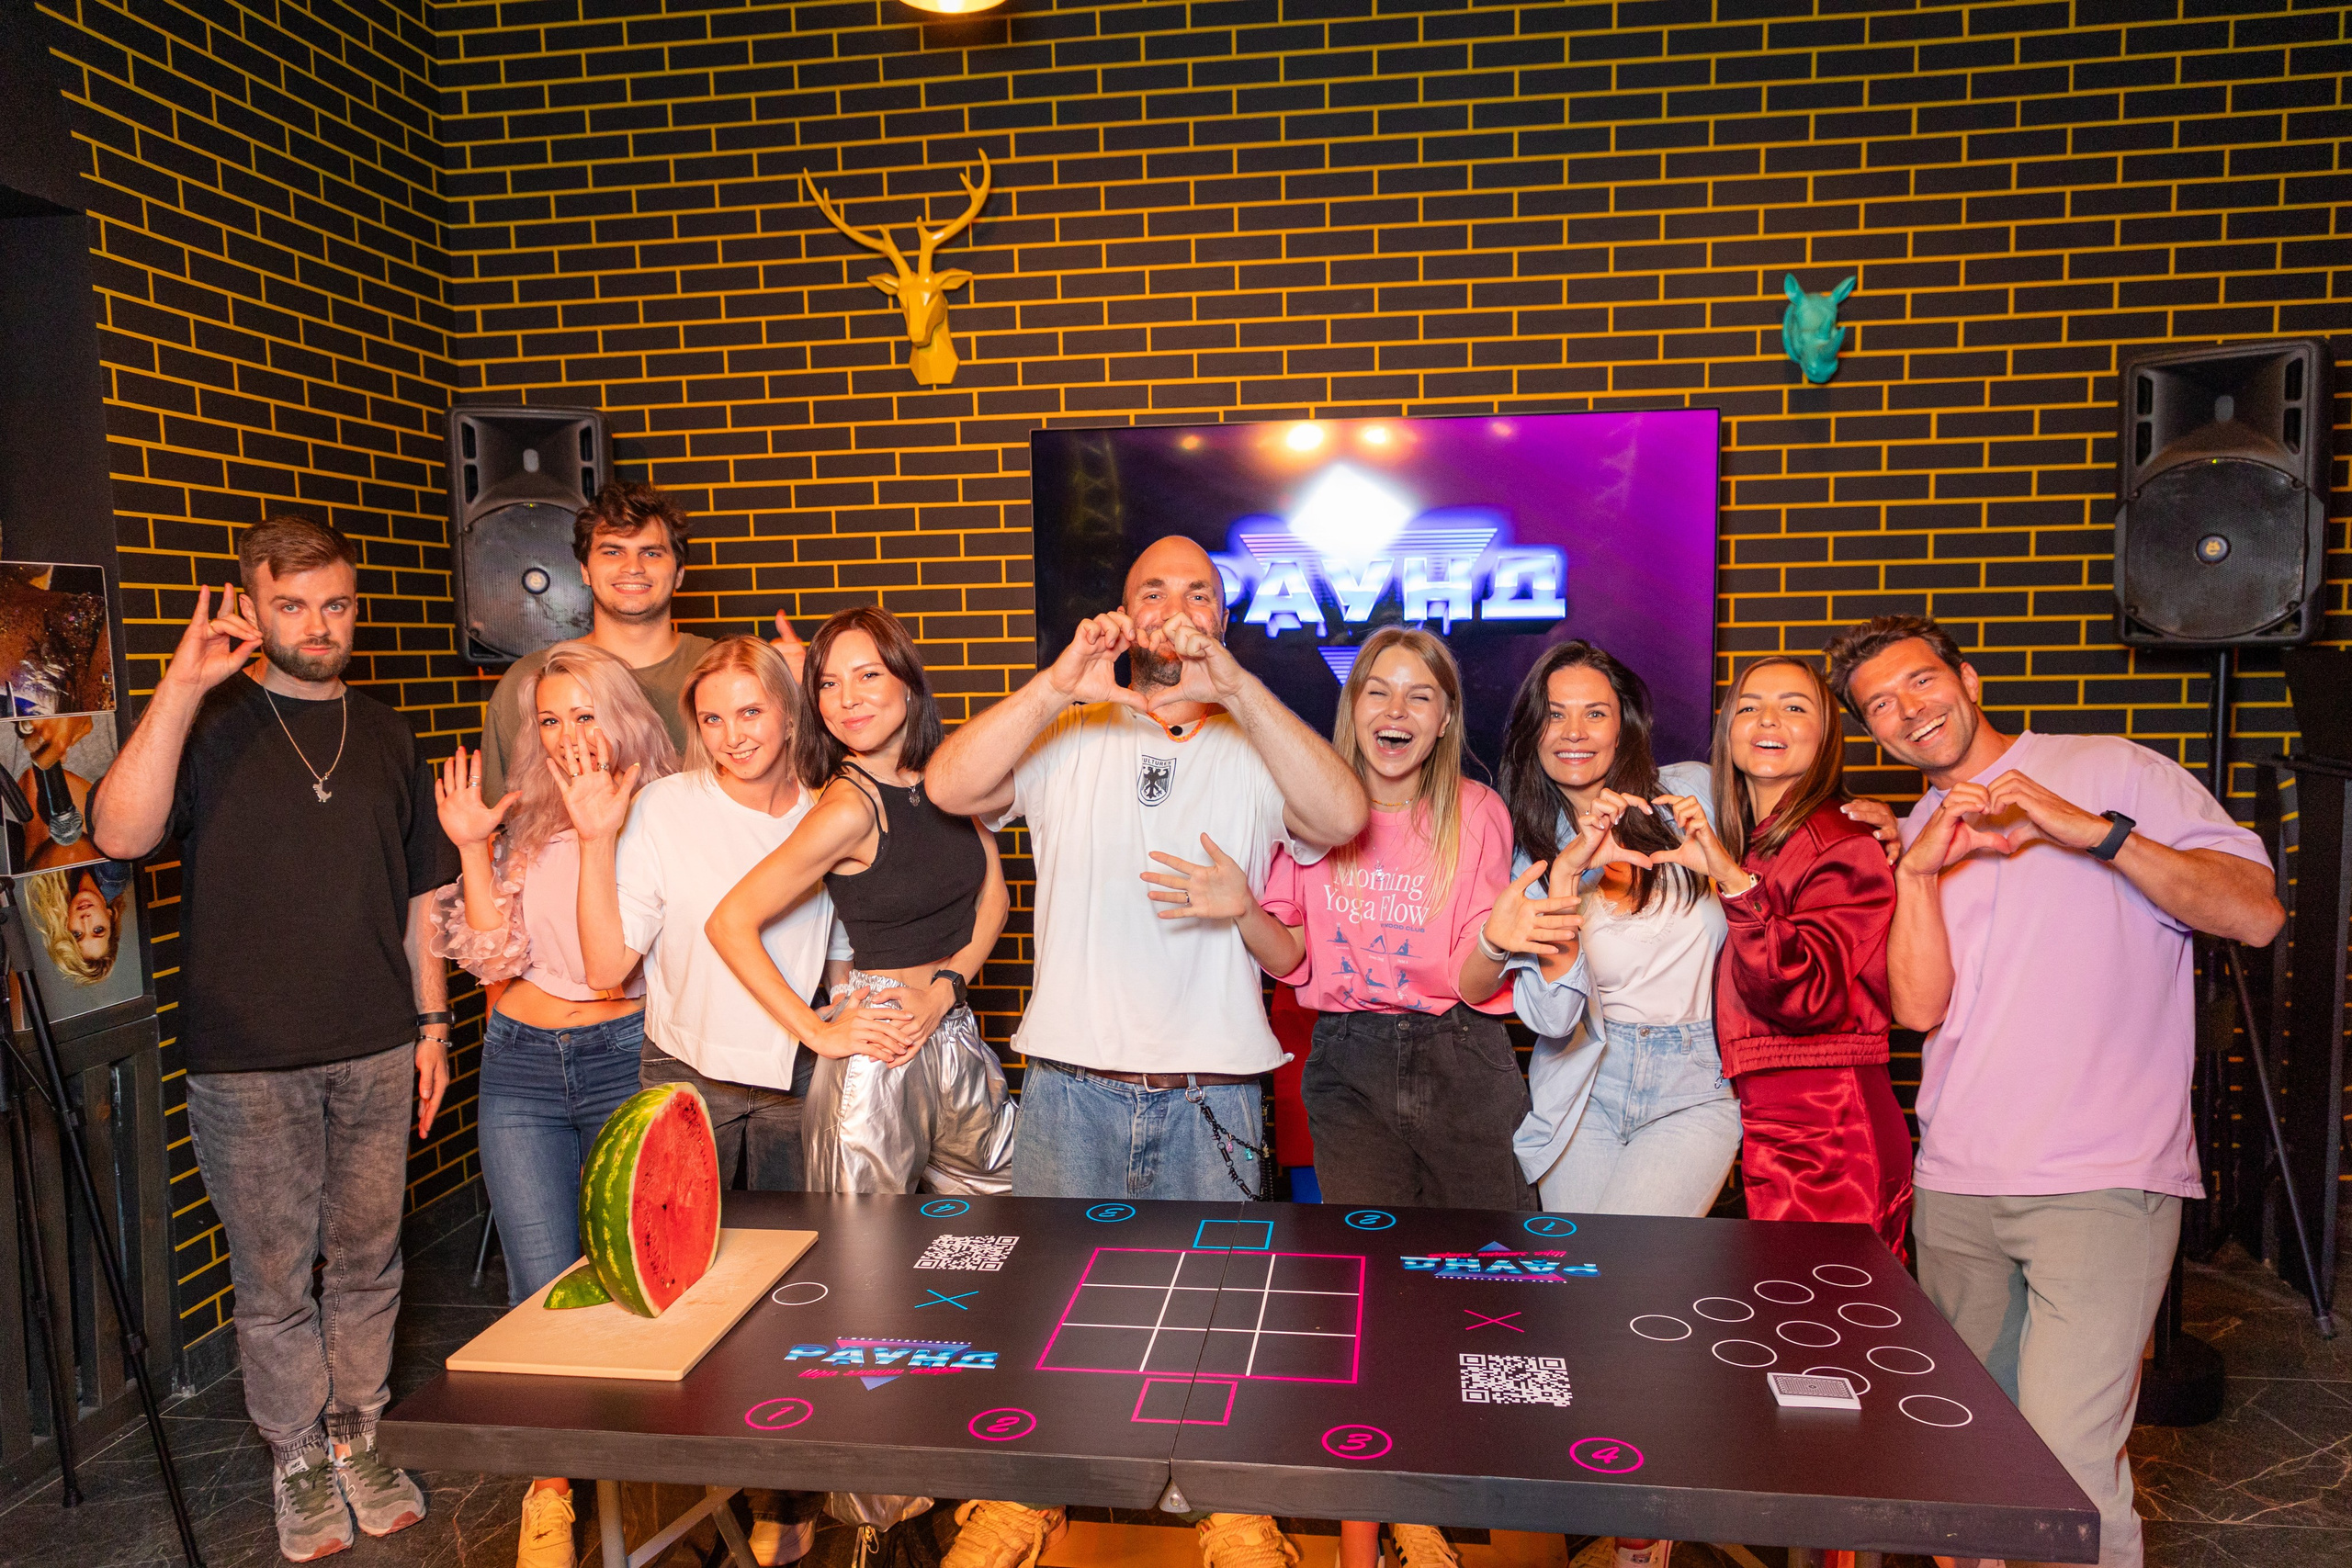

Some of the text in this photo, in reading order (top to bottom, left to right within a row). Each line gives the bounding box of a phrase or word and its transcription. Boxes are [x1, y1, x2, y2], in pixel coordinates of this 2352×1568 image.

[1333, 866, 1426, 901] Morning
[1323, 884, 1430, 927] Yoga Flow
[1400, 1256, 1601, 1280] РАУНД
[784, 1344, 1000, 1370] РАУНД
[767, 1405, 795, 1422] 1
[986, 1416, 1021, 1433] 2
[1338, 1433, 1374, 1451] 3
[1591, 1446, 1621, 1464] 4
